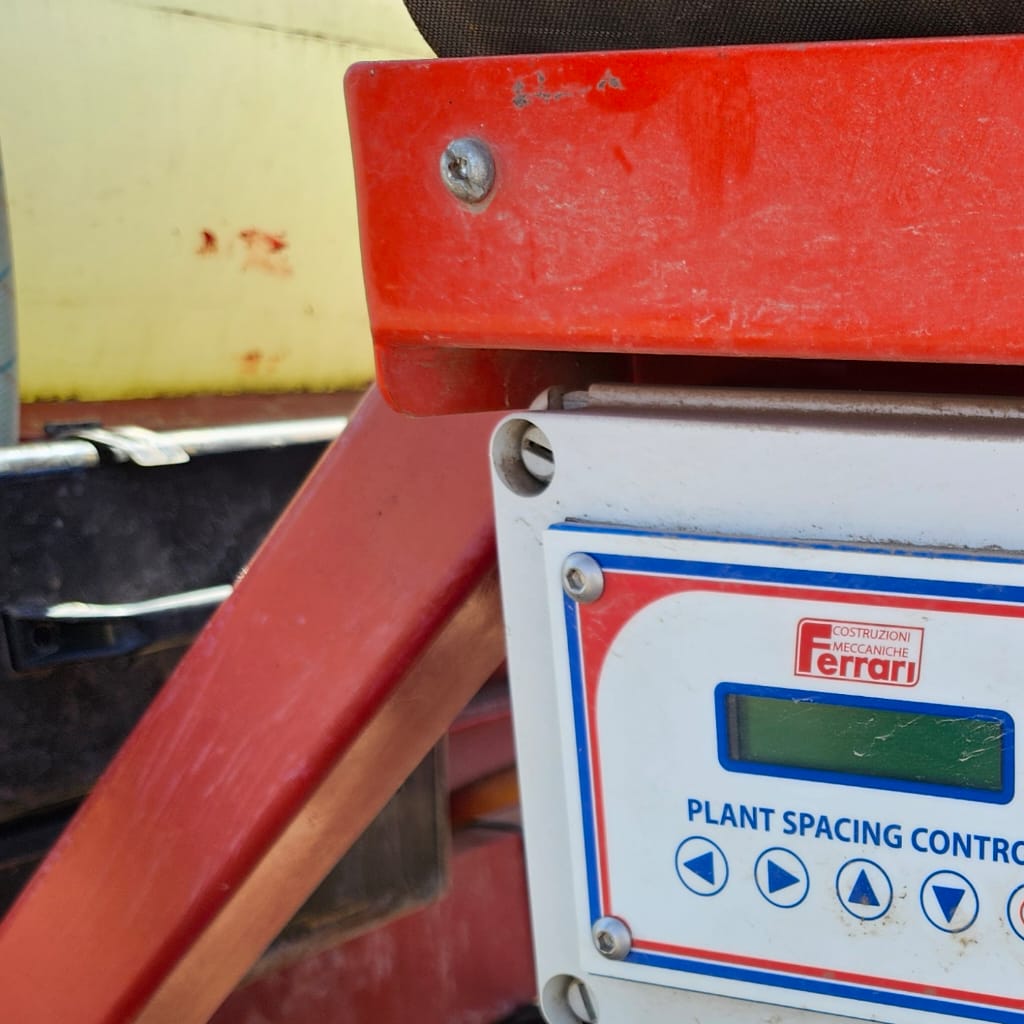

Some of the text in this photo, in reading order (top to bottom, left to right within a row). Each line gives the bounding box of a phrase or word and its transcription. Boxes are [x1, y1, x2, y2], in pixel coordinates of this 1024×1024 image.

[832, 641, 909, 658] MECCANICHE
[833, 625, 911, 643] COSTRUZIONI
[798, 622, 916, 684] Ferrari
[687, 798, 775, 832] PLANT
[782, 810, 903, 849] SPACING
